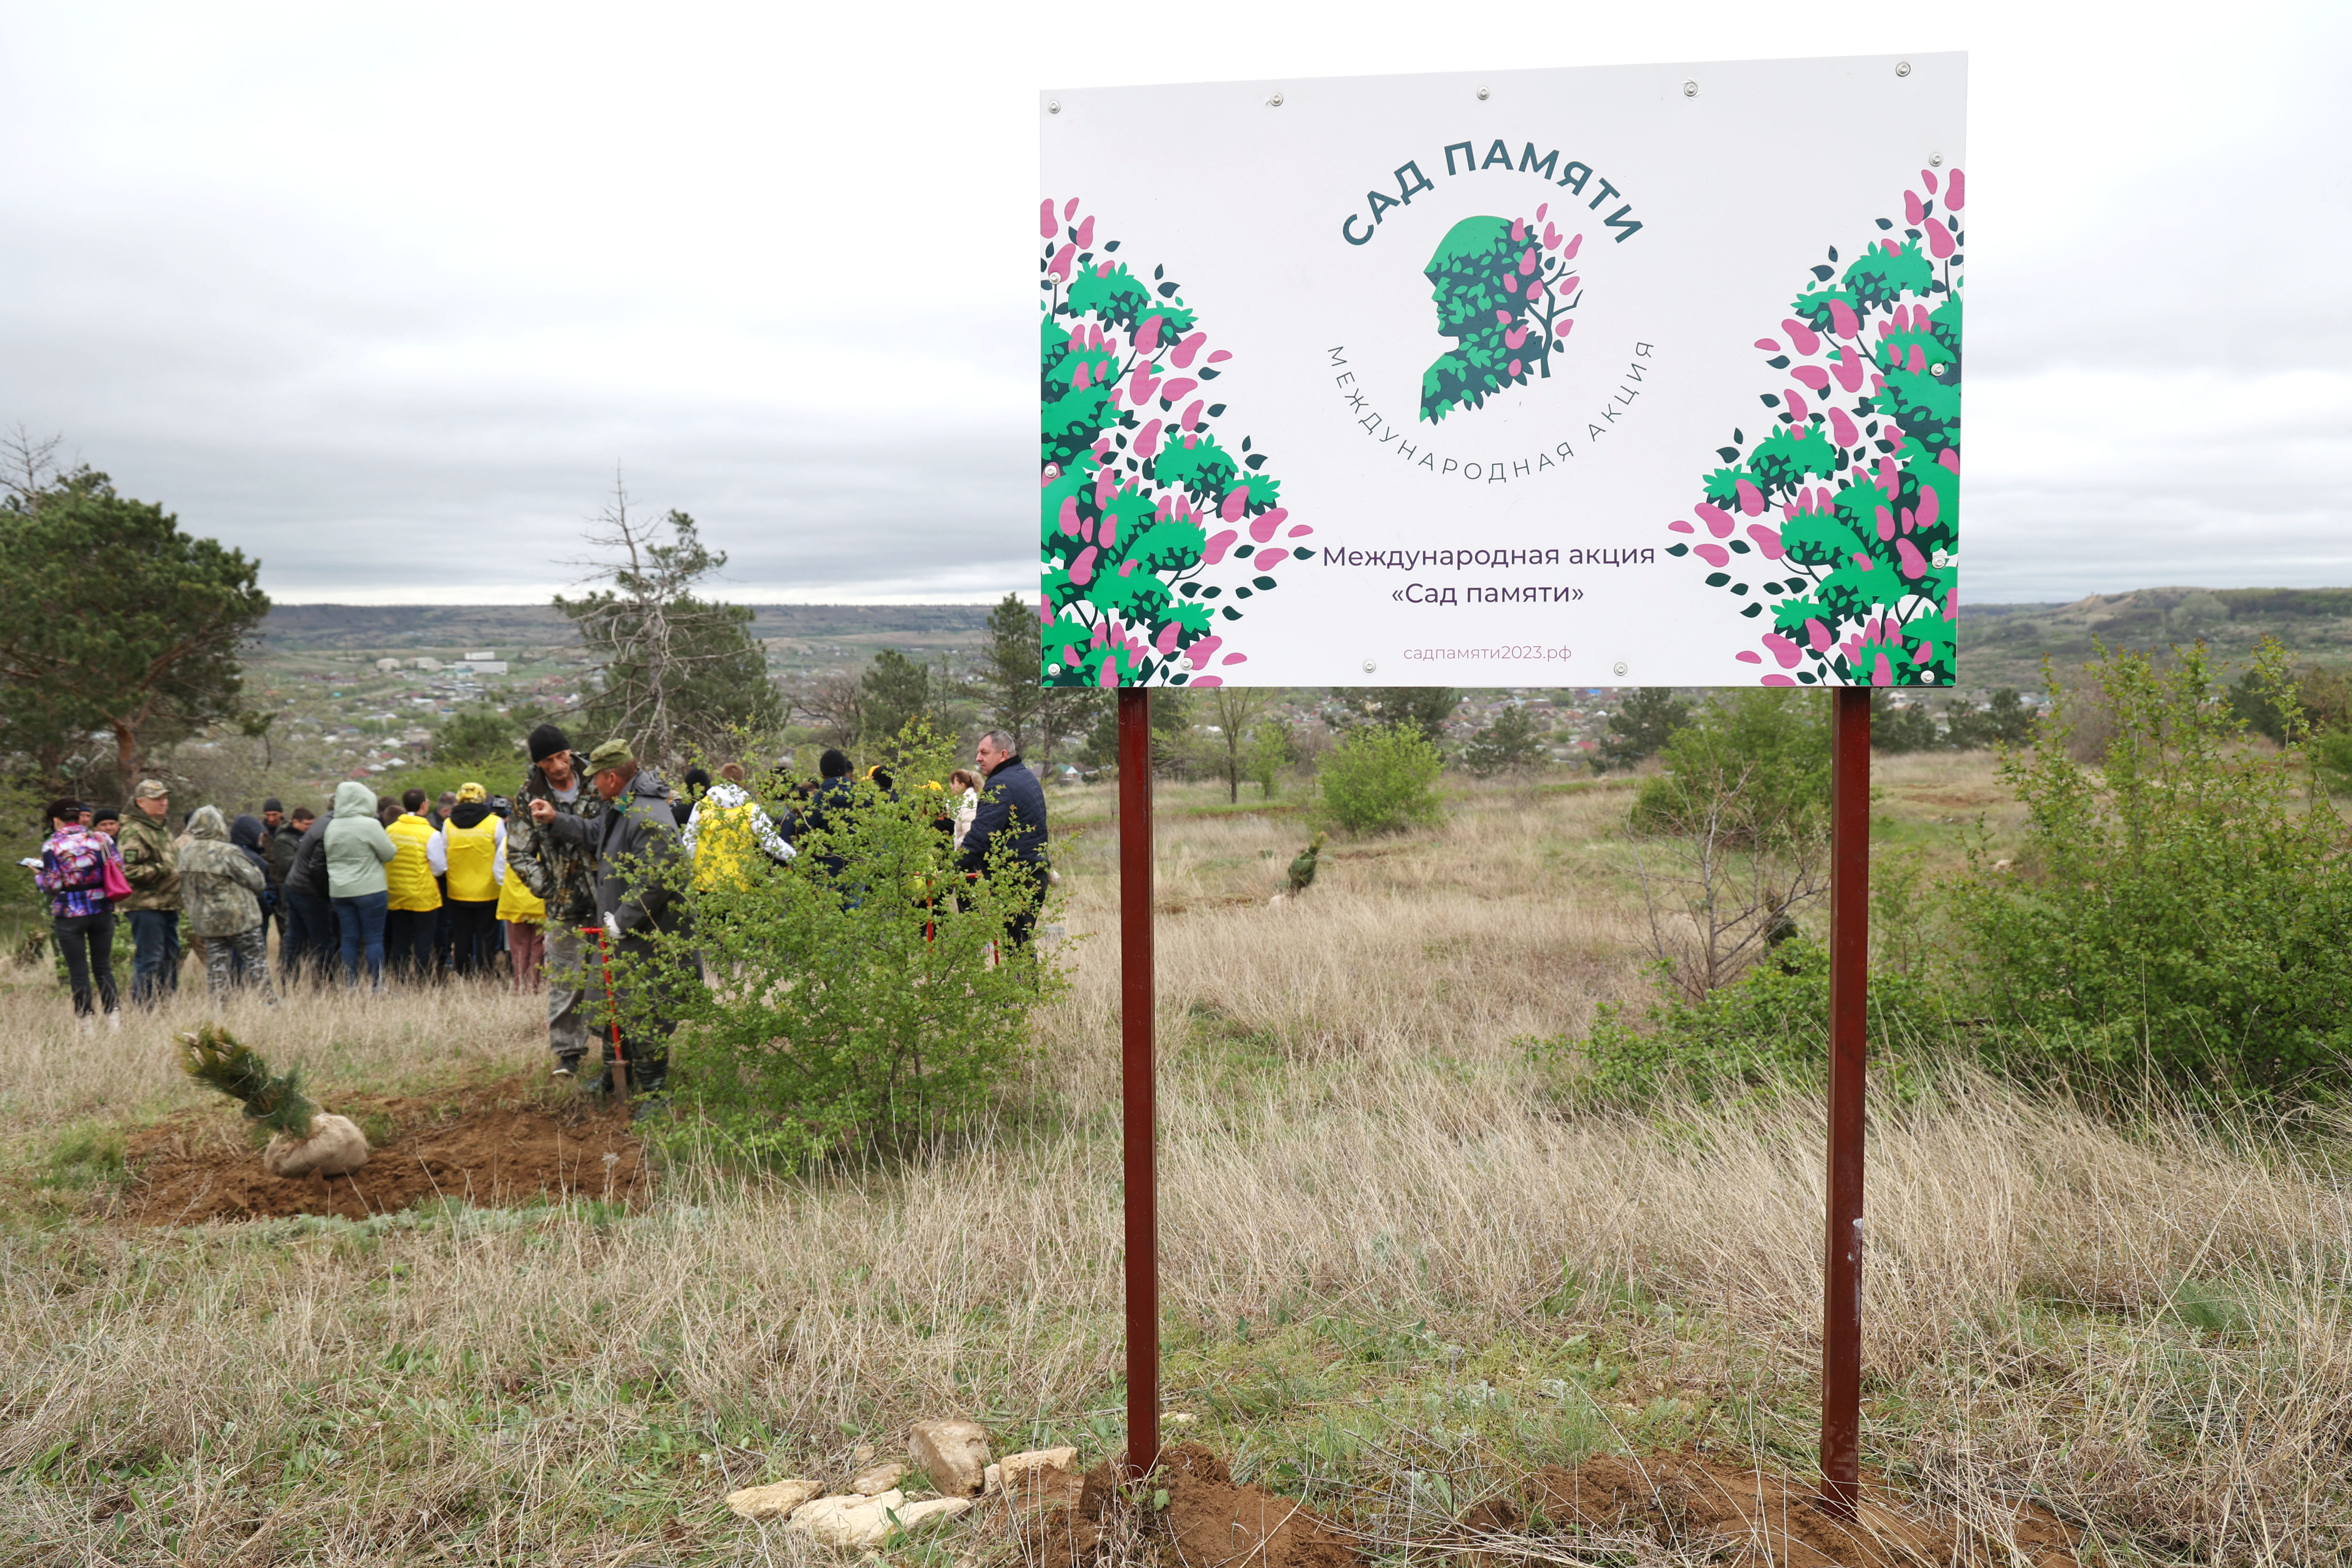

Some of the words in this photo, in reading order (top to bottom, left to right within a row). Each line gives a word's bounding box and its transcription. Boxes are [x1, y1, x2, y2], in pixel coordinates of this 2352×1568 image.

[1342, 159, 1435, 246] САД
[1443, 139, 1644, 244] ПАМЯТИ
[1327, 346, 1574, 484] МЕЖДУНАРОДНАЯ
[1588, 342, 1654, 442] АКЦИЯ
[1324, 546, 1559, 571] Международная
[1569, 548, 1654, 567] акция
[1392, 583, 1458, 606] «Сад
[1467, 587, 1584, 603] памяти»
[1403, 645, 1571, 662] садпамяти2023.рф
